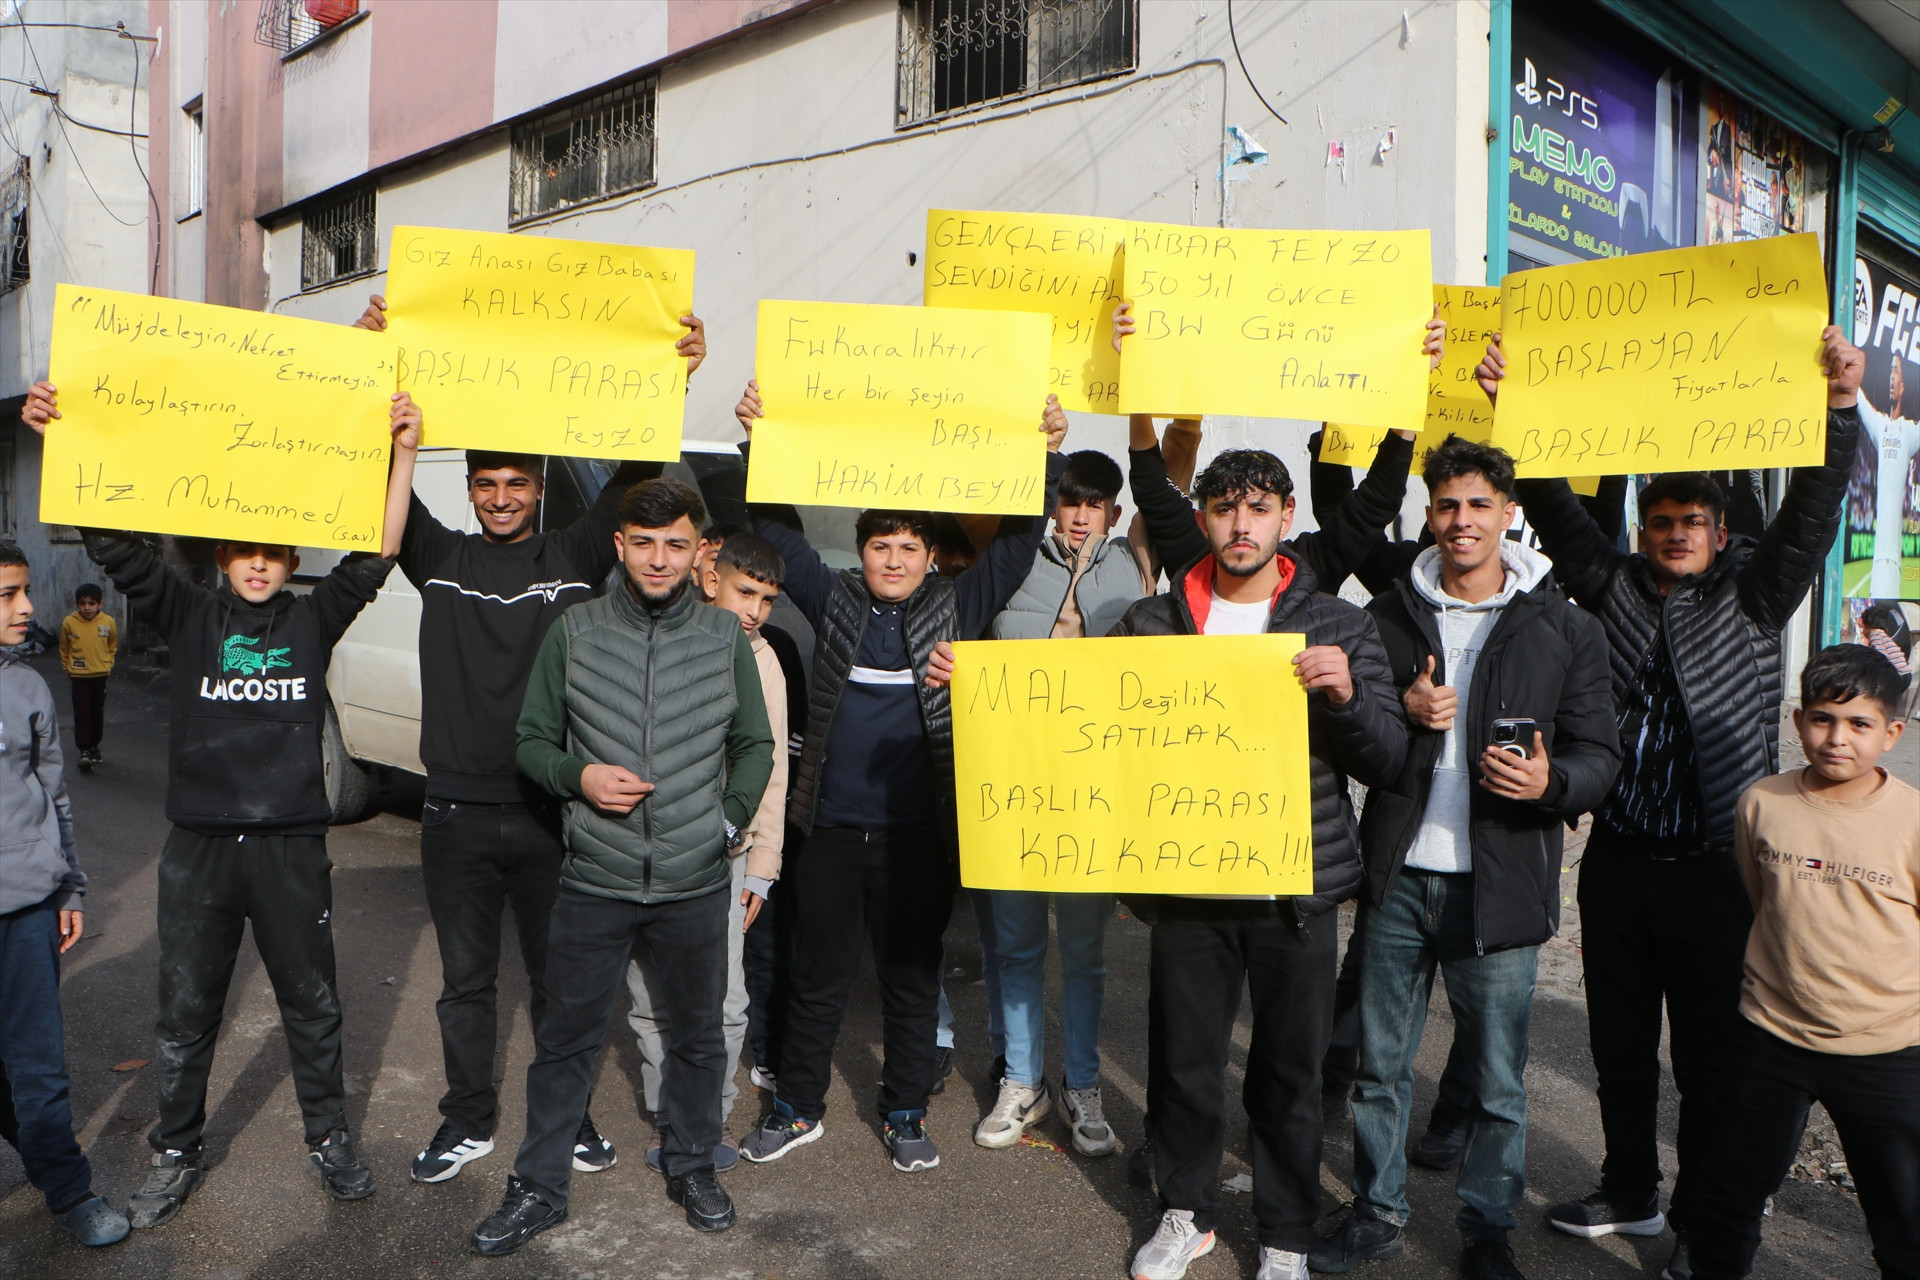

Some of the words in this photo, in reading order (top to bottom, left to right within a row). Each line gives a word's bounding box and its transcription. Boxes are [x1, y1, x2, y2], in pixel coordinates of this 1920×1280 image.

[1546, 78, 1598, 130] PS5
[1513, 115, 1616, 192] MEMO
[1509, 156, 1549, 187] PLAY
[1553, 176, 1619, 218] STATION
[1561, 204, 1572, 220] &
[469, 244, 532, 270] Anası
[597, 255, 678, 282] Babası
[1134, 227, 1236, 261] KİBAR
[1268, 238, 1400, 266] FEYZO
[930, 260, 1080, 297] SEVDİĞİNİ
[1131, 270, 1179, 298] 50
[1266, 283, 1356, 306] ÖNCE
[463, 287, 632, 322] KALKSIN
[1509, 278, 1647, 330] 700.000
[1528, 314, 1750, 388] BAŞLAYAN
[550, 356, 678, 399] PARASI
[806, 372, 845, 401] Her
[865, 374, 892, 400] bir
[1518, 426, 1660, 466] BAŞLIK
[1688, 418, 1821, 459] PARASI
[815, 459, 922, 499] HAKİM
[168, 474, 345, 524] Muhammed
[200, 676, 307, 702] LACOSTE
[969, 662, 1085, 715] MAL
[978, 783, 1111, 822] BAŞLIK
[1147, 783, 1287, 820] PARASI
[1826, 861, 1893, 888] HILFIGER
